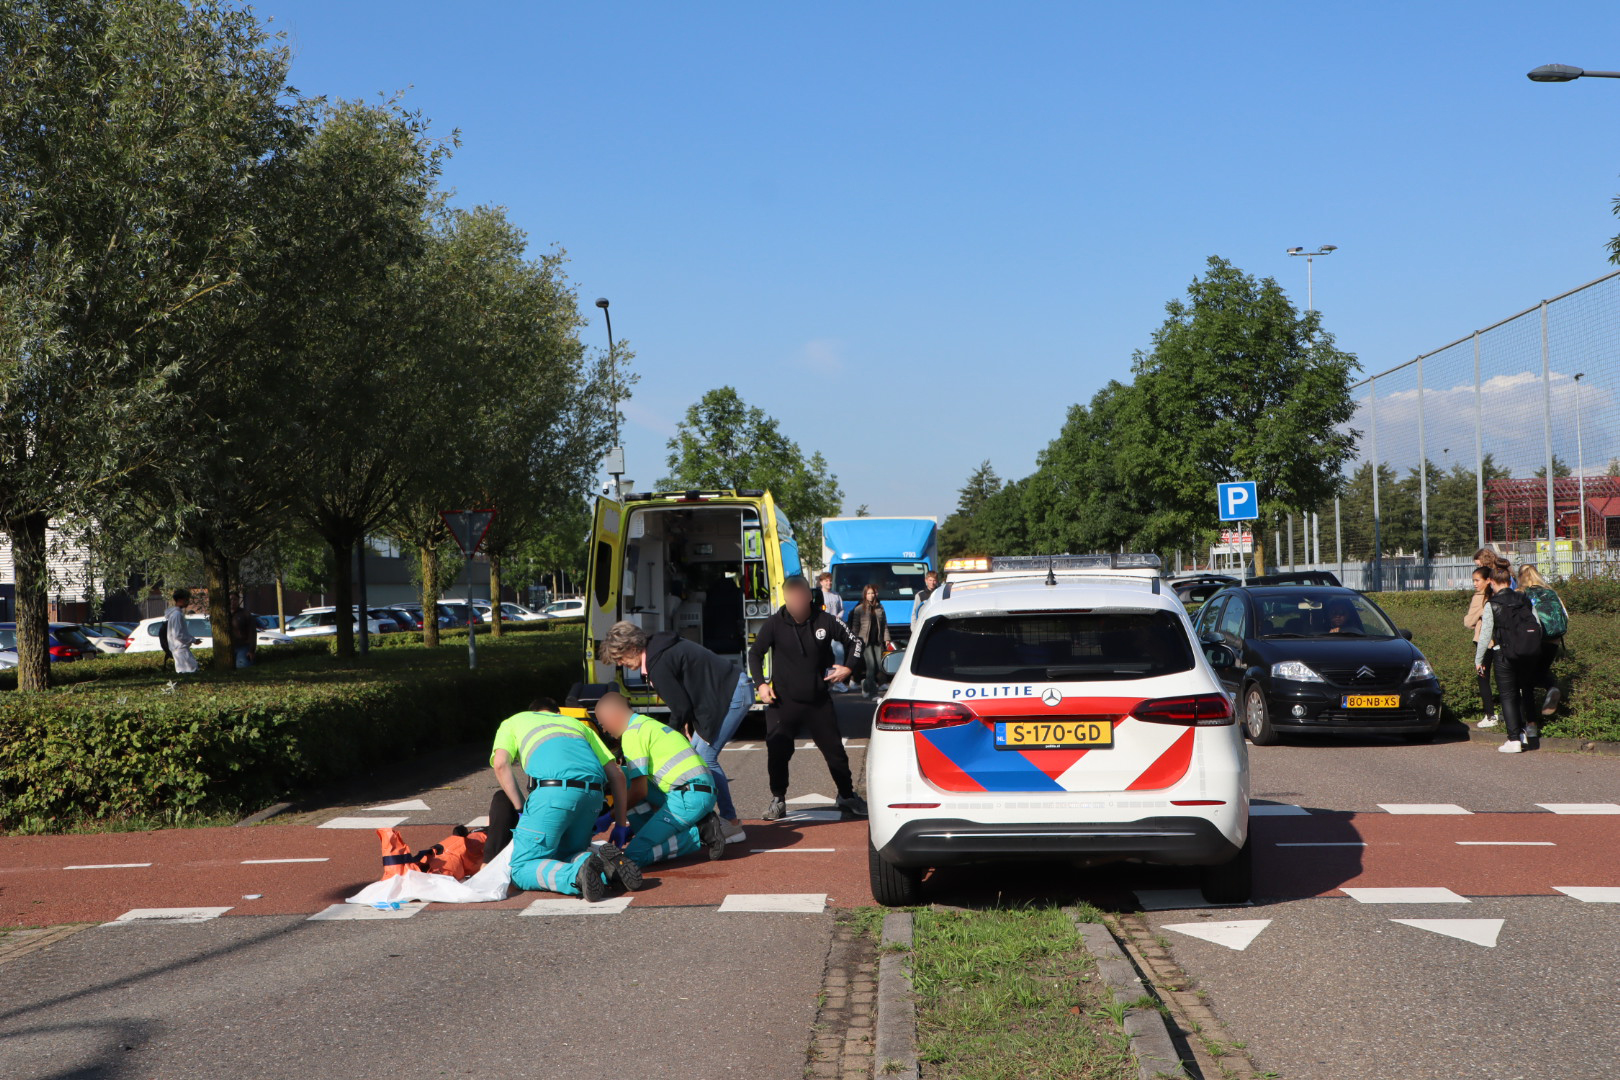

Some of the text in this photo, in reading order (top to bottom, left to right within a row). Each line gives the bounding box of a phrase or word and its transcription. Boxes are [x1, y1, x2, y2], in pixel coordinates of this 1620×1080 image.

[1228, 487, 1249, 515] P
[952, 686, 1033, 699] POLITIE
[1349, 697, 1396, 706] 80-NB-XS
[1013, 724, 1101, 742] S-170-GD
